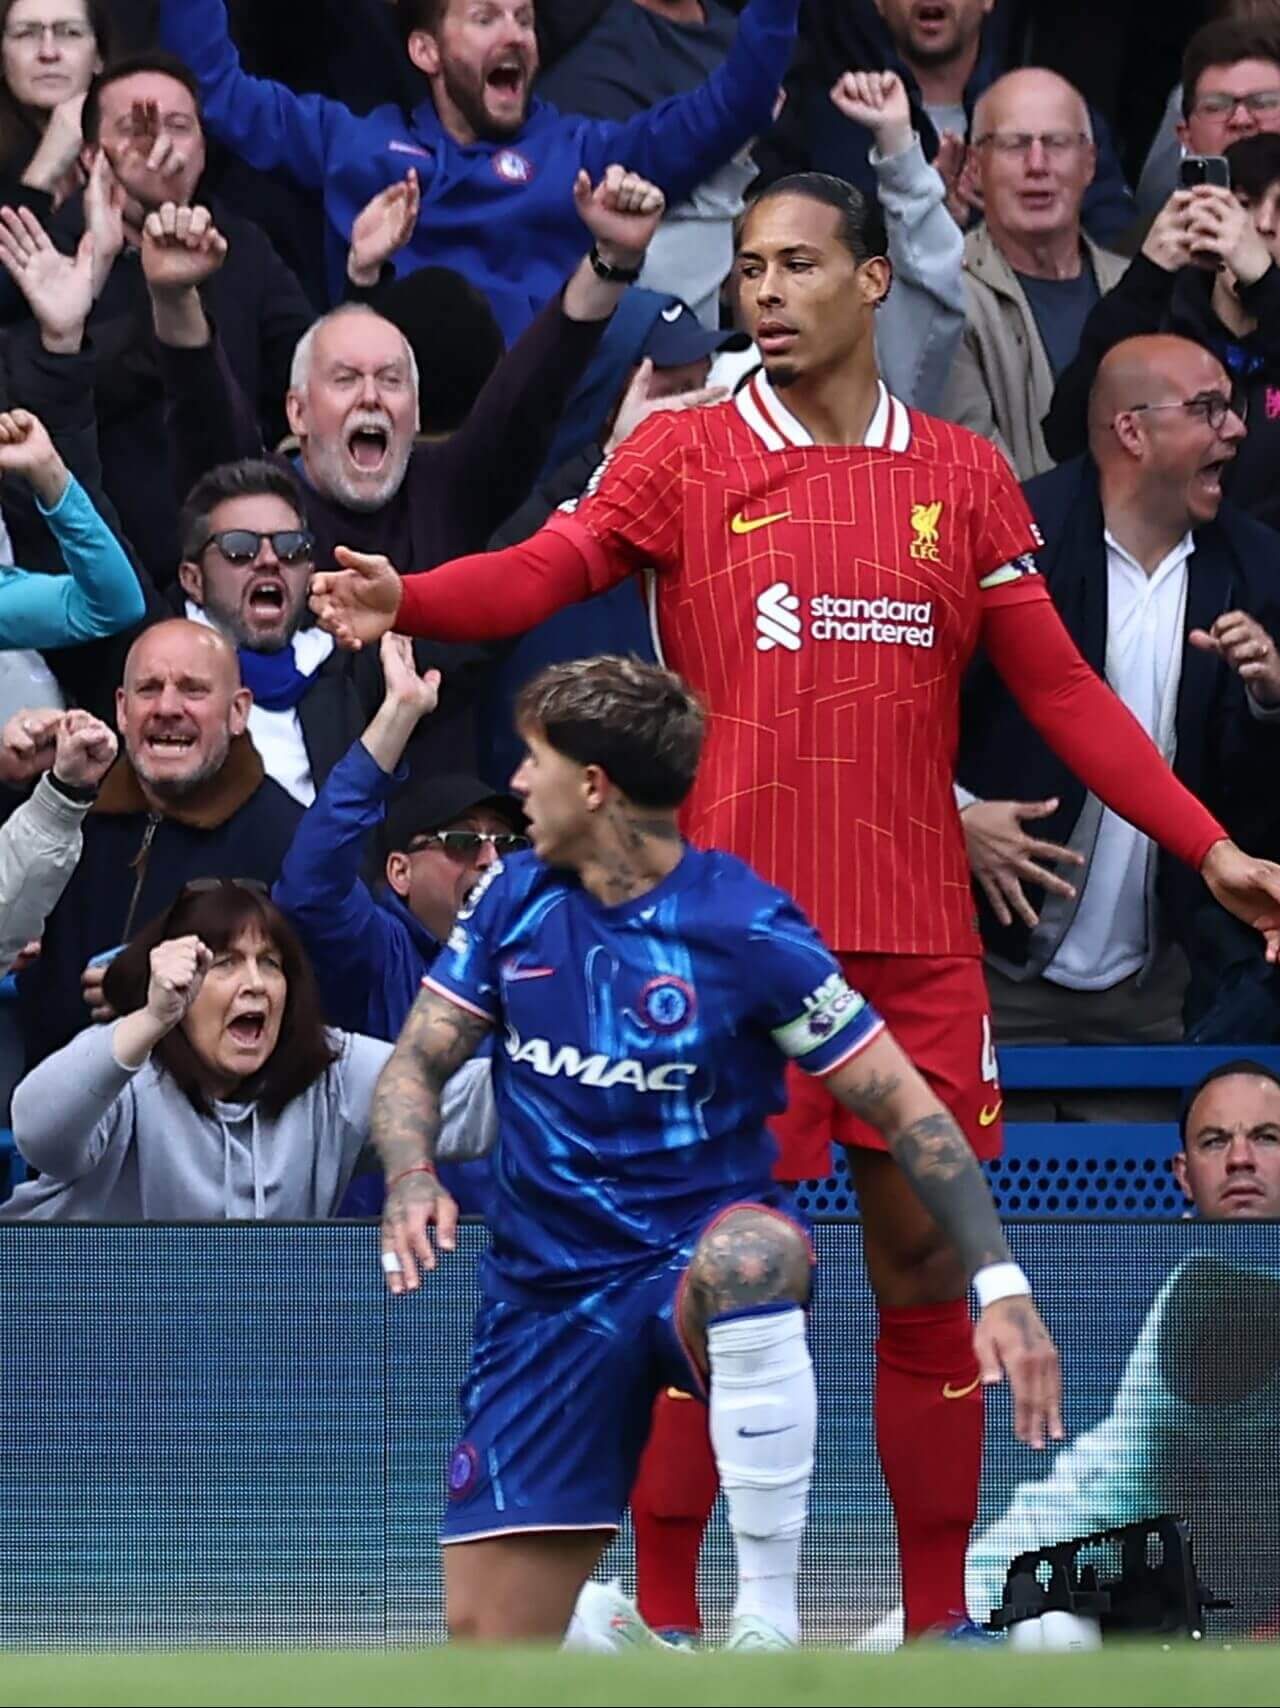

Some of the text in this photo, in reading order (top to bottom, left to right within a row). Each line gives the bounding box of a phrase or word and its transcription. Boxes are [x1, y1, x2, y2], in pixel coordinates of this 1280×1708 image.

[910, 543, 941, 562] LFC
[810, 594, 932, 624] standard
[810, 617, 935, 648] chartered
